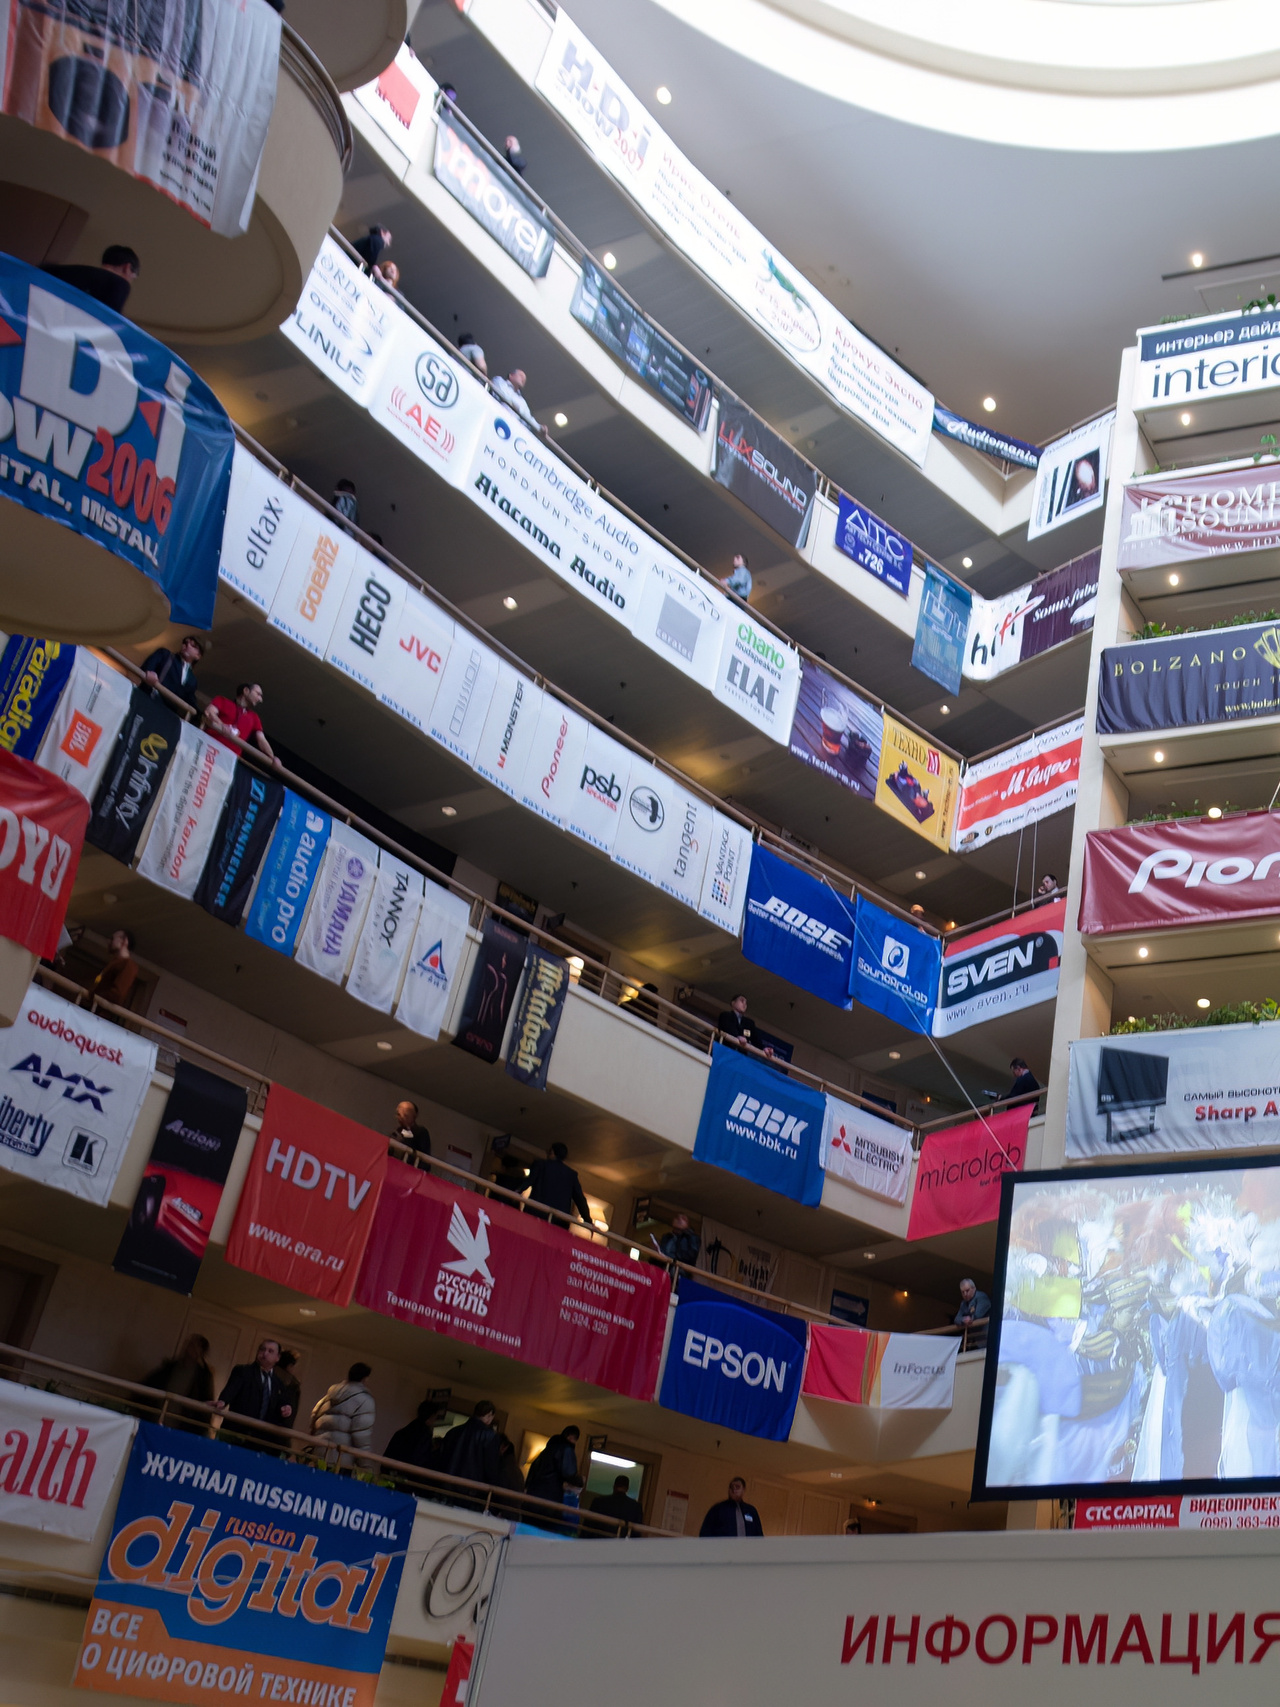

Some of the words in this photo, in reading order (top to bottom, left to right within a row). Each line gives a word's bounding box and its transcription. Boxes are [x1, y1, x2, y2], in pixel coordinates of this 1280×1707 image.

[447, 155, 548, 263] morel
[295, 309, 366, 386] LINIUS
[946, 418, 1039, 466] Audiomania
[86, 426, 176, 536] 2006
[514, 437, 594, 519] Cambridge
[594, 512, 640, 556] Audio
[246, 496, 283, 570] eltax
[475, 473, 562, 560] Atacama
[570, 553, 626, 611] Audio
[349, 575, 392, 656] HECO
[1032, 597, 1070, 623] Sonus
[399, 634, 442, 674] JVC
[735, 639, 783, 681] loudspeakers
[736, 622, 785, 670] chario
[1114, 646, 1247, 678] BOLZANO
[1214, 677, 1261, 693] TOUCH
[501, 680, 525, 756] MONSTER
[192, 743, 221, 810] harman
[541, 715, 569, 799] Pioneer
[115, 754, 160, 831] Infinity
[580, 765, 622, 804] psb
[169, 815, 198, 881] kardon
[215, 804, 259, 907] SENNHEISER
[285, 832, 317, 899] audio
[674, 802, 699, 879] tangent
[271, 898, 297, 944] pro
[322, 879, 360, 957] YAMAHA
[383, 871, 409, 948] TANNOY
[749, 896, 852, 950] BOSE
[947, 939, 1034, 997] SVEN
[518, 957, 563, 1075] McIntosh
[945, 983, 1030, 1022] www.sven.ru
[27, 1010, 124, 1067] audioquest
[728, 1092, 808, 1146] BBK
[1184, 1088, 1224, 1102] САМЫЙ
[1195, 1103, 1257, 1123] Sharp
[725, 1119, 798, 1160] www.bbk.ru
[854, 1147, 899, 1174] ELECTRIC
[264, 1138, 371, 1212] HDTV
[919, 1143, 1021, 1192] microlab
[247, 1220, 345, 1273] www.era.ru
[572, 1248, 652, 1287] презентационное
[433, 1284, 489, 1317] СТИЛЬ
[436, 1270, 492, 1301] РУССКИЙ
[570, 1261, 636, 1294] оборудование
[584, 1281, 609, 1299] КАМА
[387, 1290, 451, 1324] Технологии
[453, 1315, 522, 1348] впечатлений
[562, 1296, 612, 1323] домашнее
[612, 1314, 635, 1330] кино
[683, 1328, 787, 1394] EPSON
[893, 1361, 946, 1379] InFocus
[140, 1449, 237, 1500] ЖУРНАЛ
[239, 1478, 327, 1524] RUSSIAN
[328, 1503, 398, 1541] DIGITAL
[1113, 1502, 1175, 1521] CAPITAL
[1199, 1514, 1233, 1529] (095)
[223, 1514, 297, 1548] russian
[107, 1500, 394, 1634] digital
[90, 1607, 143, 1642] ВСЕ
[81, 1642, 101, 1671] О
[105, 1647, 254, 1702] ЦИФРОВОЙ
[260, 1671, 357, 1707] ТЕХНИКЕ
